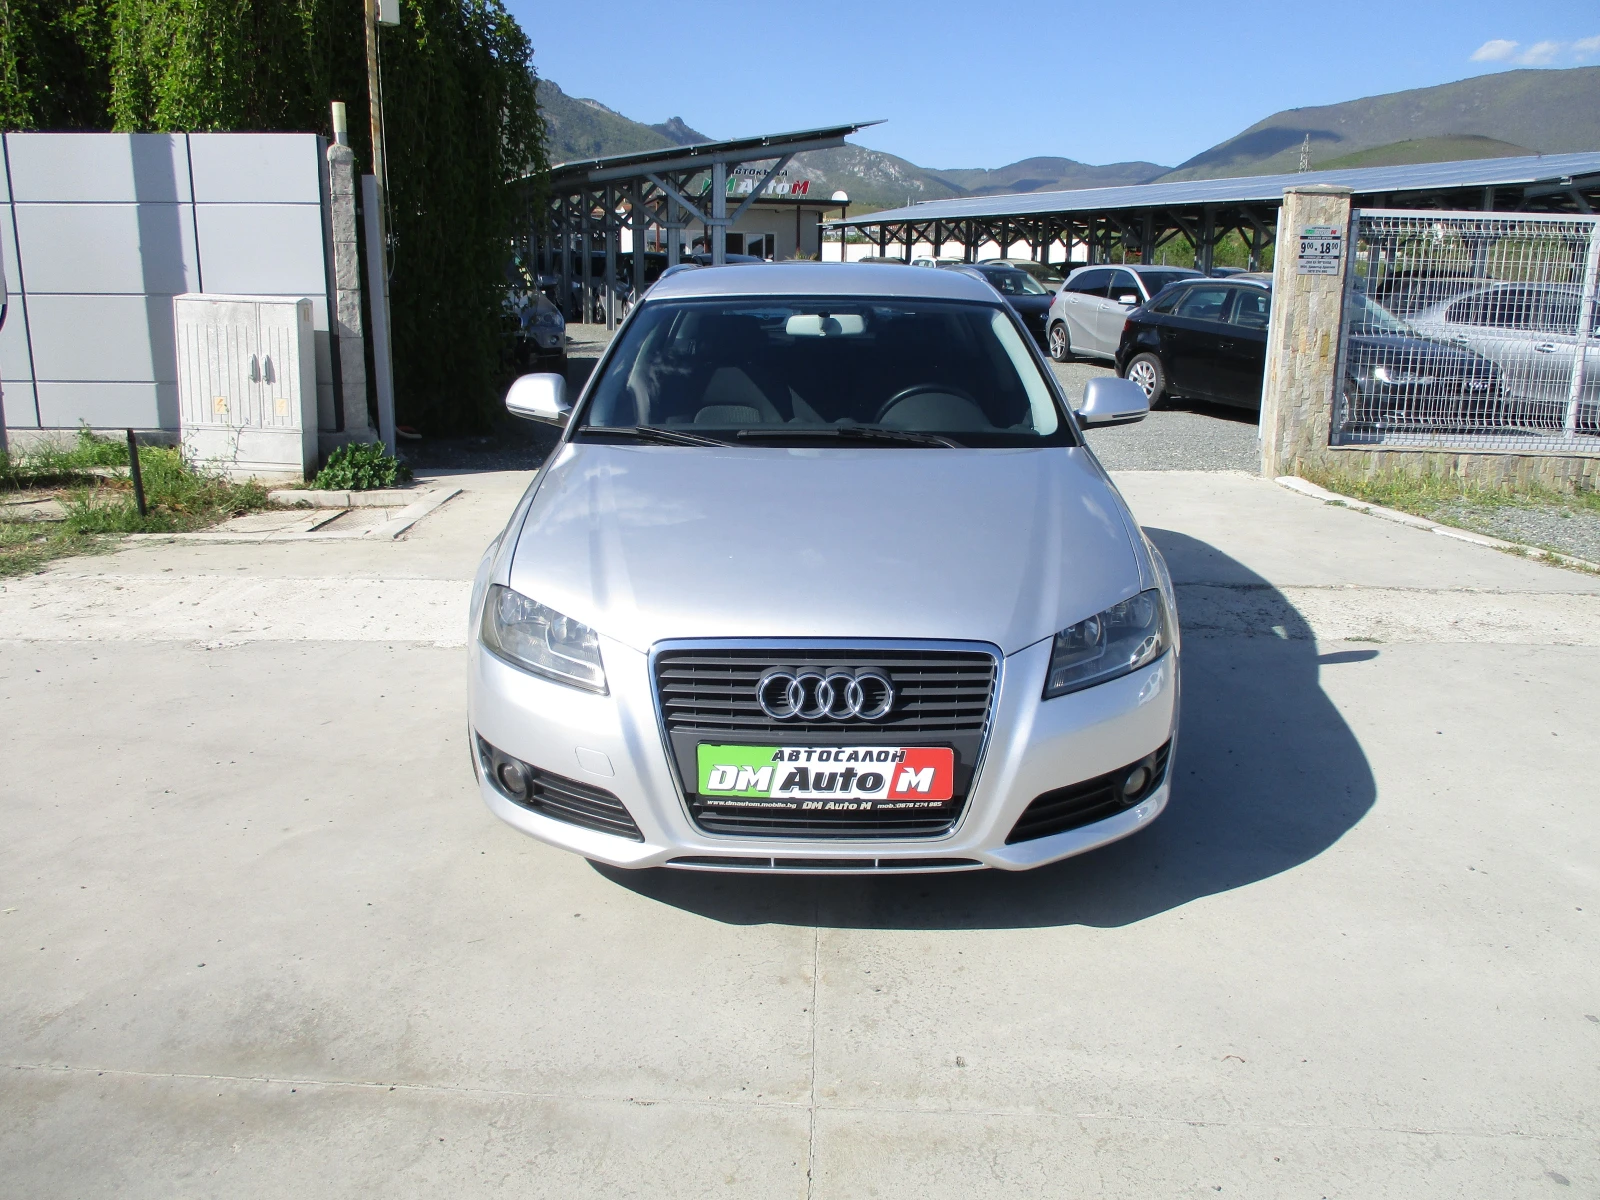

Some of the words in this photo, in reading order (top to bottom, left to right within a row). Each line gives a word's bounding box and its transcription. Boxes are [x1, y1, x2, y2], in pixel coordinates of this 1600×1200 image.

[791, 180, 810, 195] M
[771, 749, 907, 763] АВТОСАЛОН
[707, 764, 776, 792] DM
[779, 766, 886, 794] Auto
[895, 767, 936, 793] M
[707, 800, 797, 809] www.dmautom.mobile.bg
[802, 801, 824, 810] DM
[825, 801, 858, 810] Auto
[860, 801, 872, 810] M
